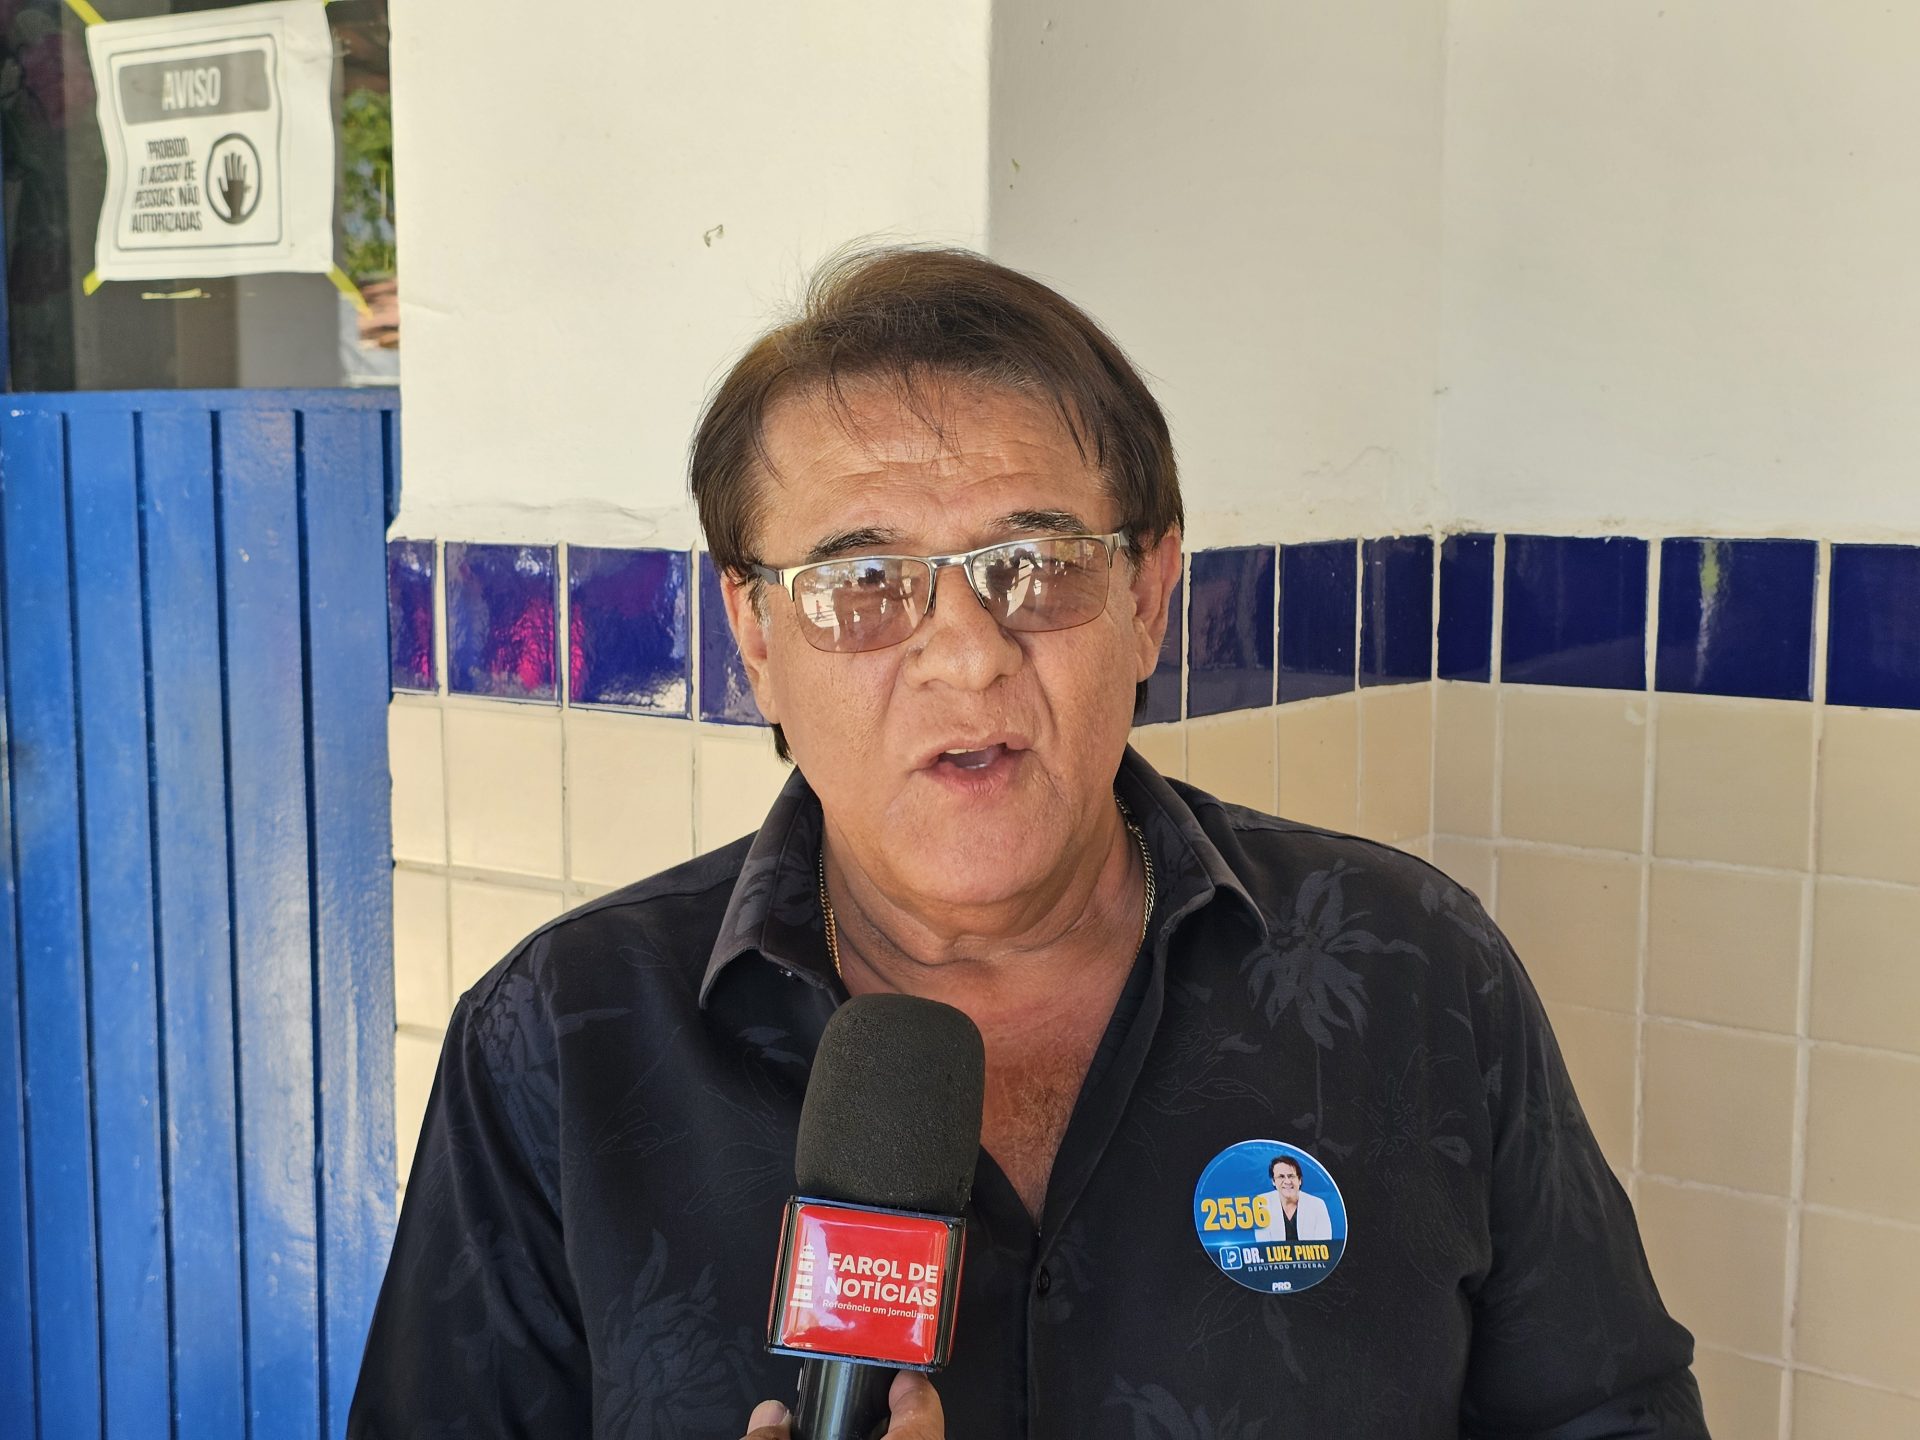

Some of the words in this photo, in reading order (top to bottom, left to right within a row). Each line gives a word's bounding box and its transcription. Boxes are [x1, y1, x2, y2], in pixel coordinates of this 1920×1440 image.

[162, 66, 221, 110] AVISO
[147, 137, 190, 159] PROIBIDO
[149, 163, 182, 184] ACESSO
[184, 160, 197, 181] DE
[135, 188, 175, 208] PESSOAS
[178, 184, 200, 206] NÃO
[131, 211, 203, 233] AUTORIZADAS
[1201, 1196, 1271, 1231] 2556
[1242, 1247, 1264, 1264] DR.
[1266, 1245, 1293, 1262] LUIZ
[1294, 1244, 1330, 1261] PINTO
[828, 1252, 902, 1279] FAROL
[908, 1262, 939, 1284] DE
[1248, 1264, 1290, 1272] DEPUTADO
[824, 1274, 938, 1307] NOTÍCIAS
[1272, 1281, 1292, 1291] PRD
[822, 1300, 871, 1313] Referência
[872, 1307, 887, 1315] em
[887, 1307, 935, 1321] jornalismo
